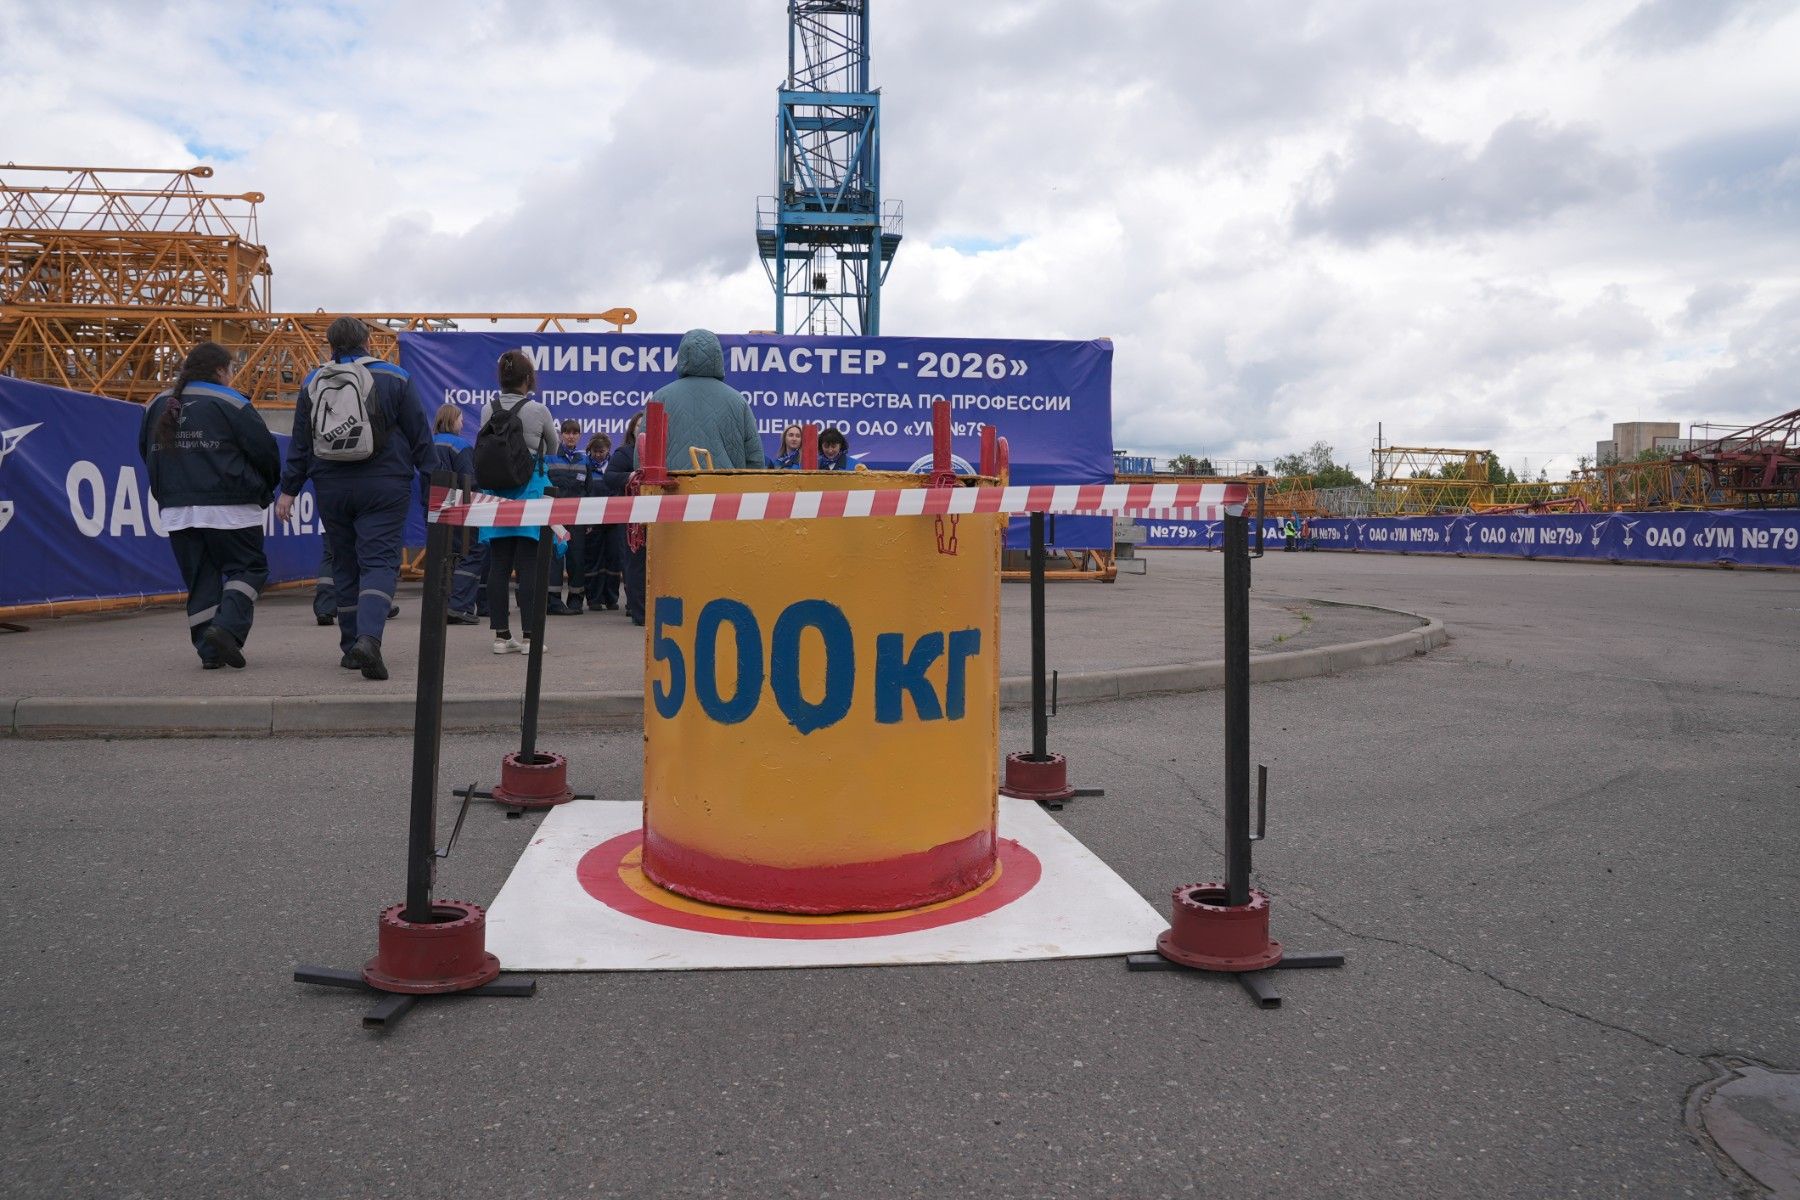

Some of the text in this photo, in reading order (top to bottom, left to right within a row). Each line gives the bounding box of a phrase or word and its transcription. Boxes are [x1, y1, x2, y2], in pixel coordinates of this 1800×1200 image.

[498, 346, 679, 373] МИНСКИ
[730, 347, 887, 374] МАСТЕР
[917, 352, 1029, 380] 2026»
[784, 392, 913, 409] МАСТЕРСТВА
[951, 394, 1071, 411] ПРОФЕССИИ
[323, 415, 358, 443] arena
[856, 420, 898, 437] ОАО
[951, 421, 987, 437] №79
[1150, 525, 1197, 539] №79»
[1369, 528, 1440, 542] ОАО «УМ №79»
[1480, 527, 1583, 545] ОАО «УМ №79»
[1645, 527, 1686, 547] ОАО
[1693, 527, 1735, 548] «УМ
[652, 595, 855, 735] 500
